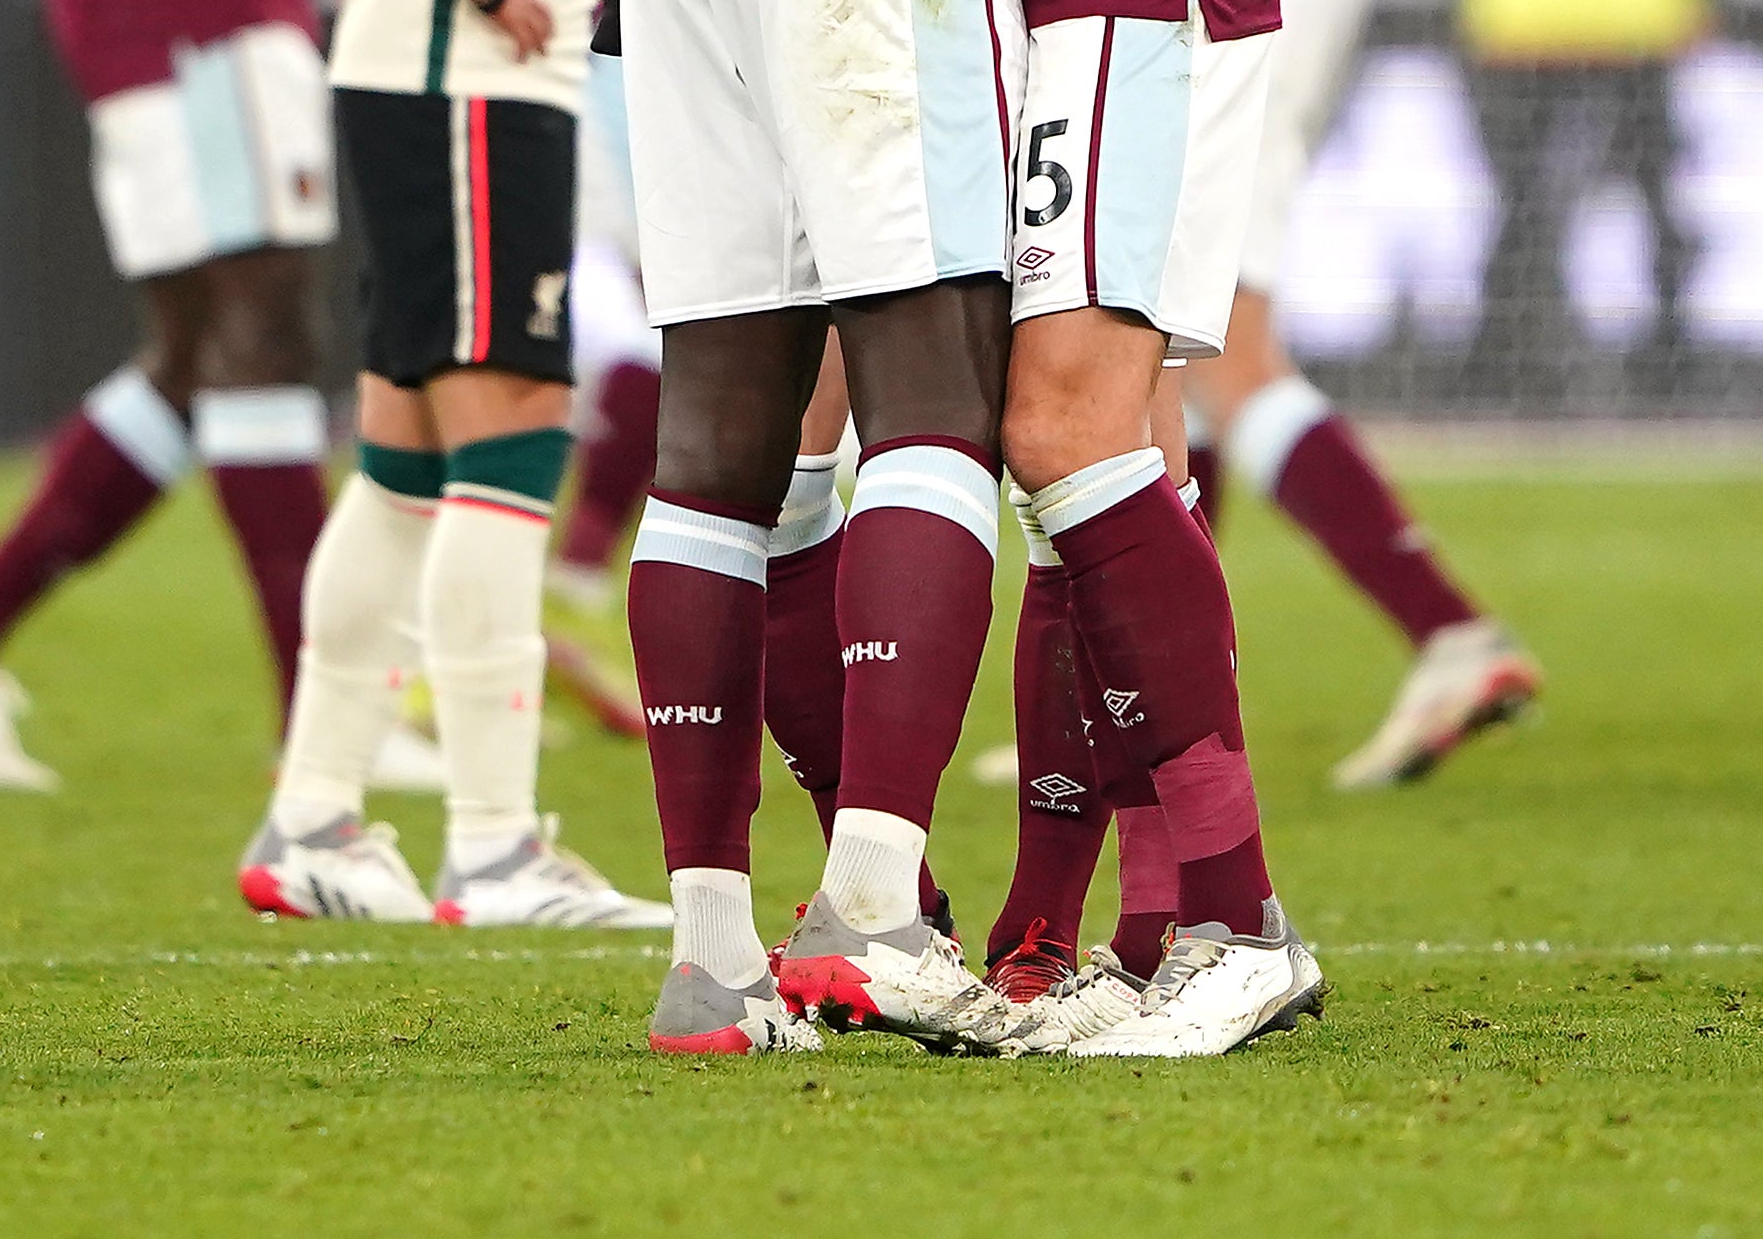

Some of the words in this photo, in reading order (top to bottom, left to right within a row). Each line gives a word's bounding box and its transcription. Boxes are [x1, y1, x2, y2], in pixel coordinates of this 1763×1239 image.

[1019, 270, 1051, 286] umbro
[841, 641, 899, 668] WHU
[646, 705, 723, 726] WHU
[1029, 797, 1081, 813] umbro
